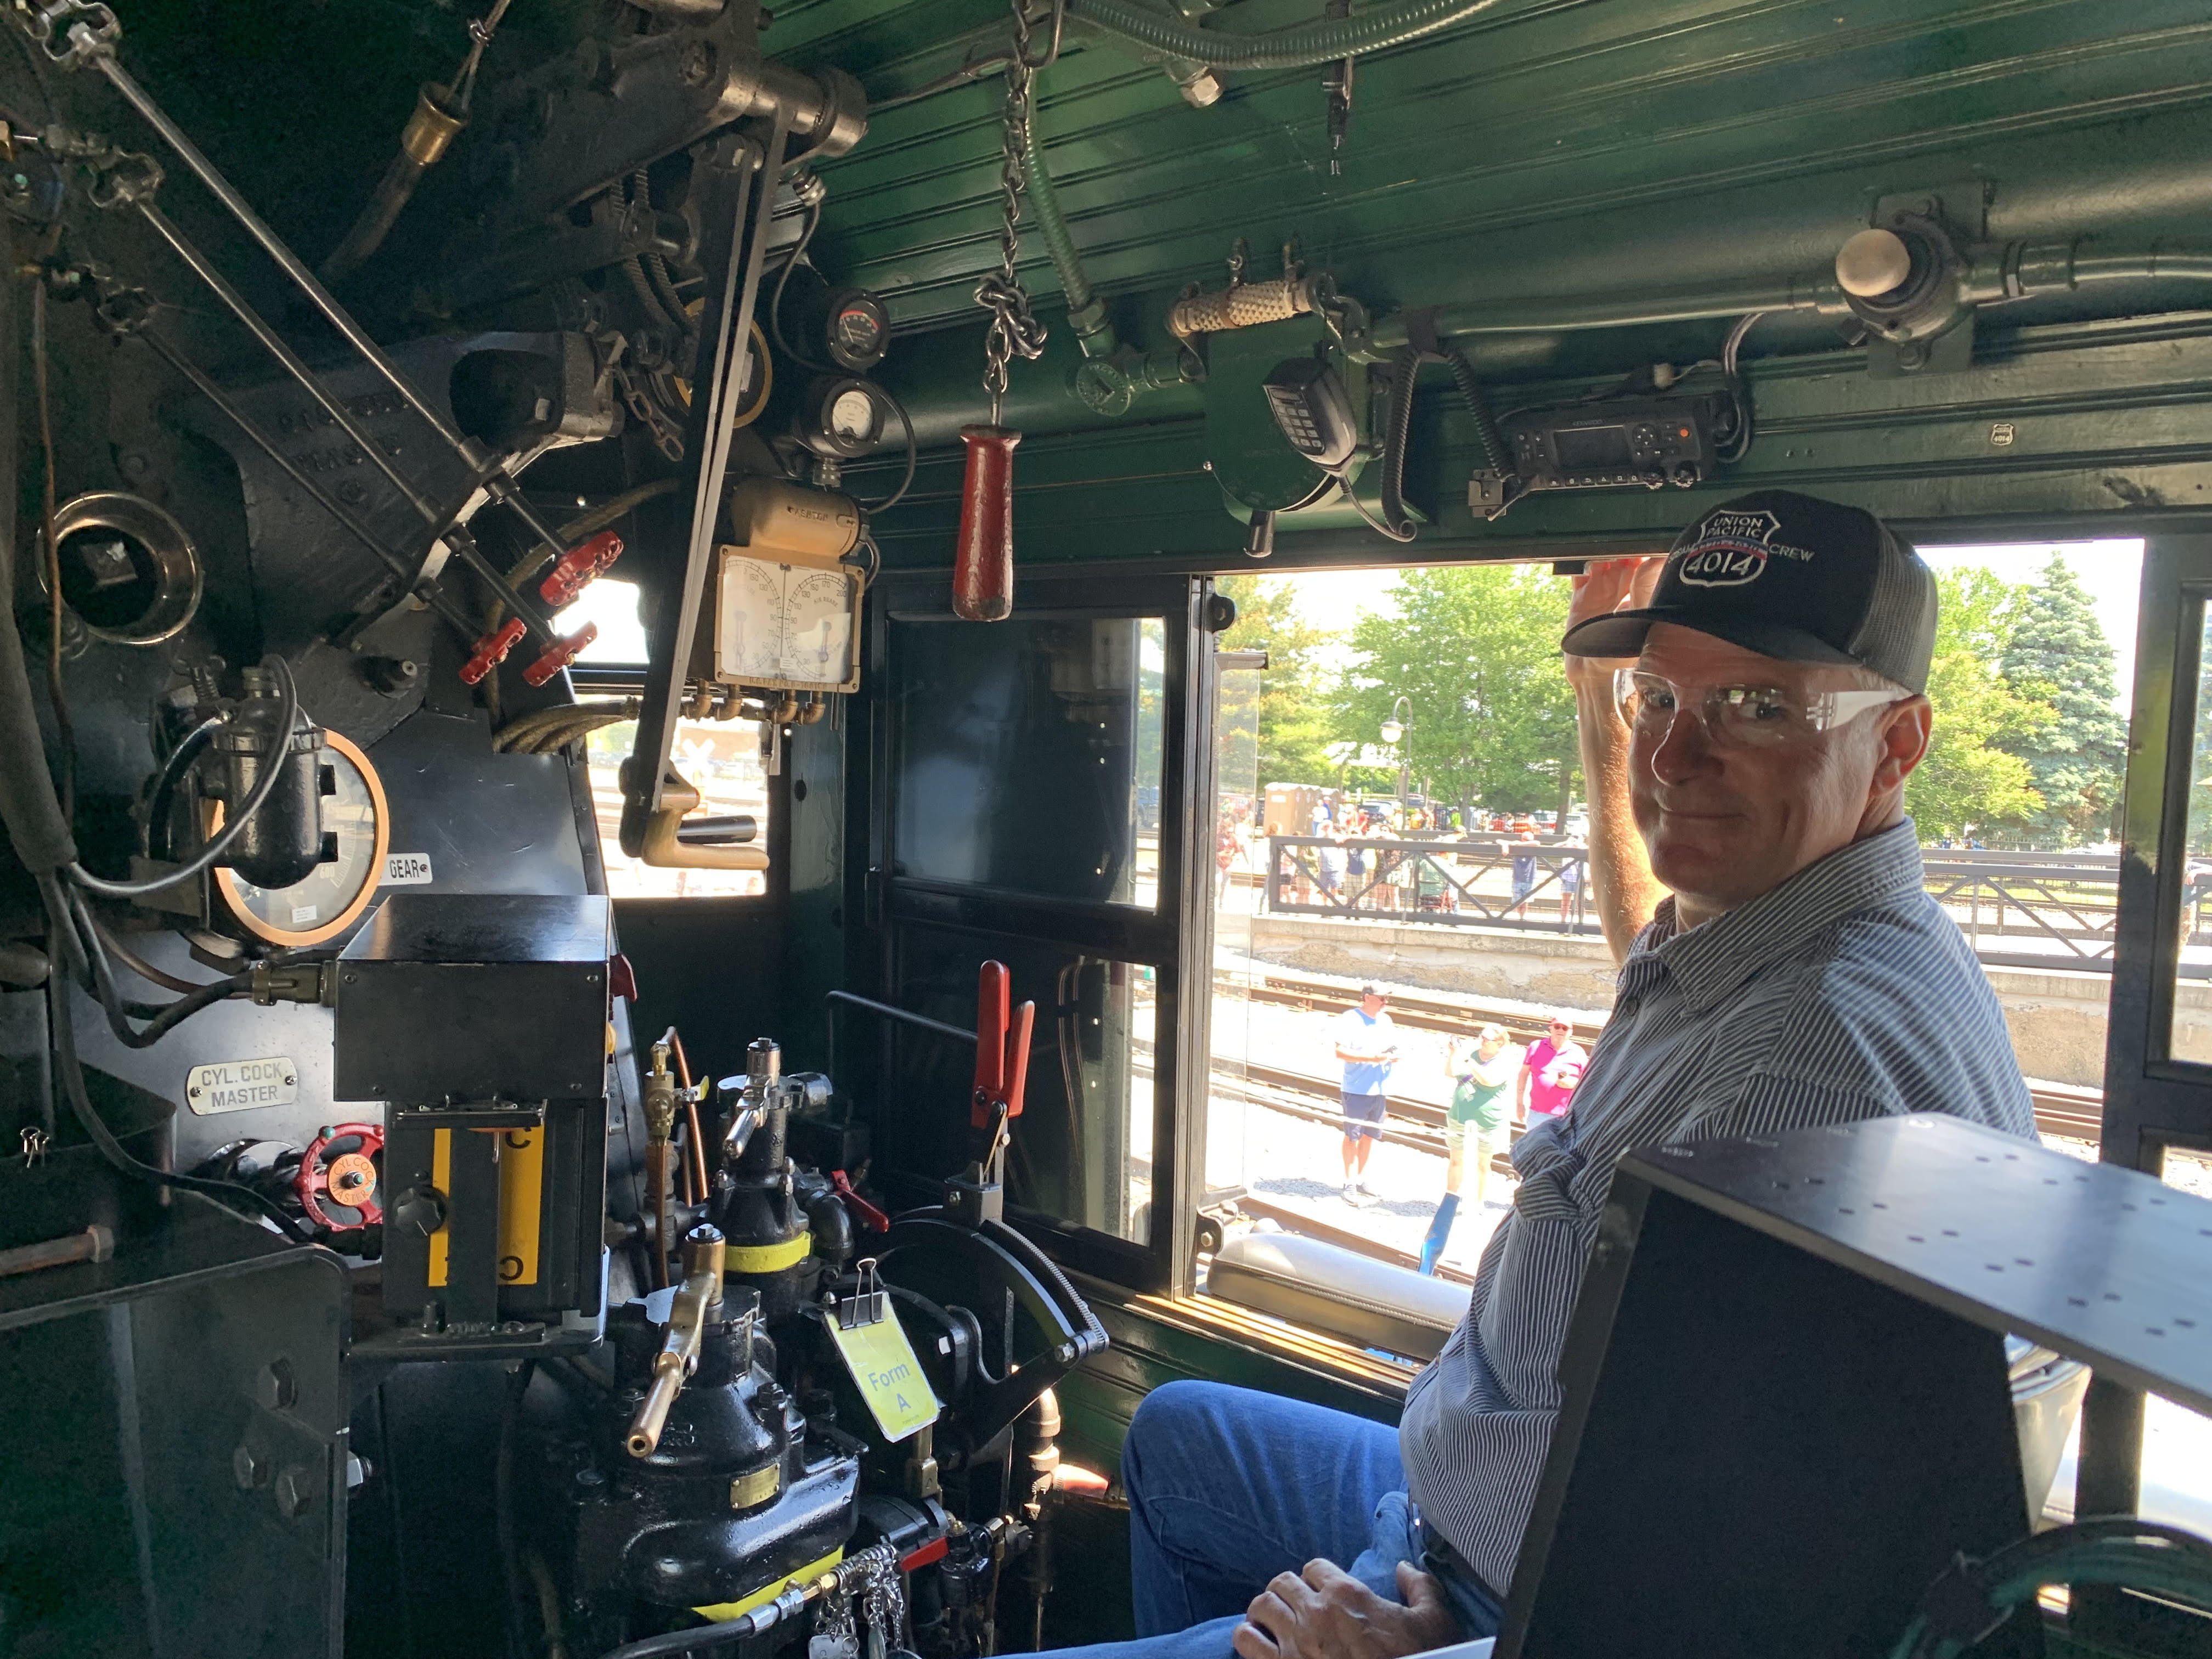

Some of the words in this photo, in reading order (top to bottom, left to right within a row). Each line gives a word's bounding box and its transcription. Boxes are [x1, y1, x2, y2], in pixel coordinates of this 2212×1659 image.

[1706, 526, 1762, 538] PACIFIC
[1713, 516, 1763, 528] UNION
[1768, 543, 1815, 563] CREW
[1686, 551, 1754, 577] 4014
[320, 865, 335, 878] 600
[390, 859, 420, 878] GEAR
[201, 1068, 238, 1086] CYL.
[240, 1062, 282, 1082] COCK
[211, 1085, 278, 1108] MASTER
[867, 1363, 911, 1392] Form
[896, 1393, 912, 1413] A
